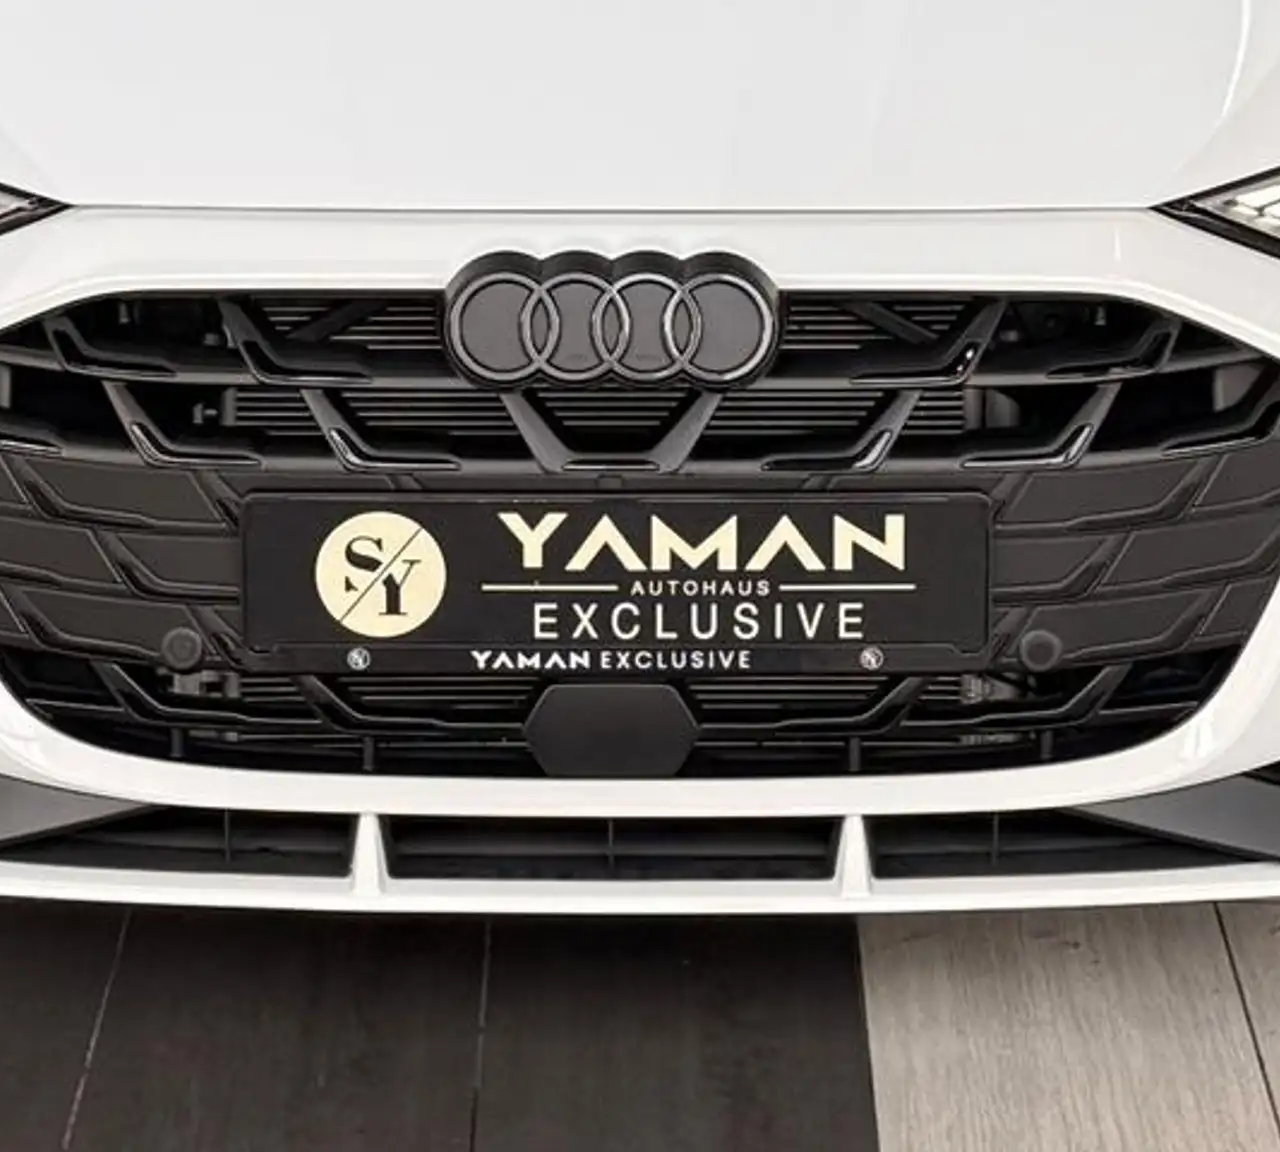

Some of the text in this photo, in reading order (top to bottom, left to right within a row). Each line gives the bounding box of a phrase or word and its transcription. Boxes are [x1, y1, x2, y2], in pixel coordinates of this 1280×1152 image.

[497, 511, 906, 572] YAMAN
[630, 579, 771, 597] AUTOHAUS
[532, 602, 865, 641] EXCLUSIVE
[470, 649, 752, 670] YAMAN EXCLUSIVE
